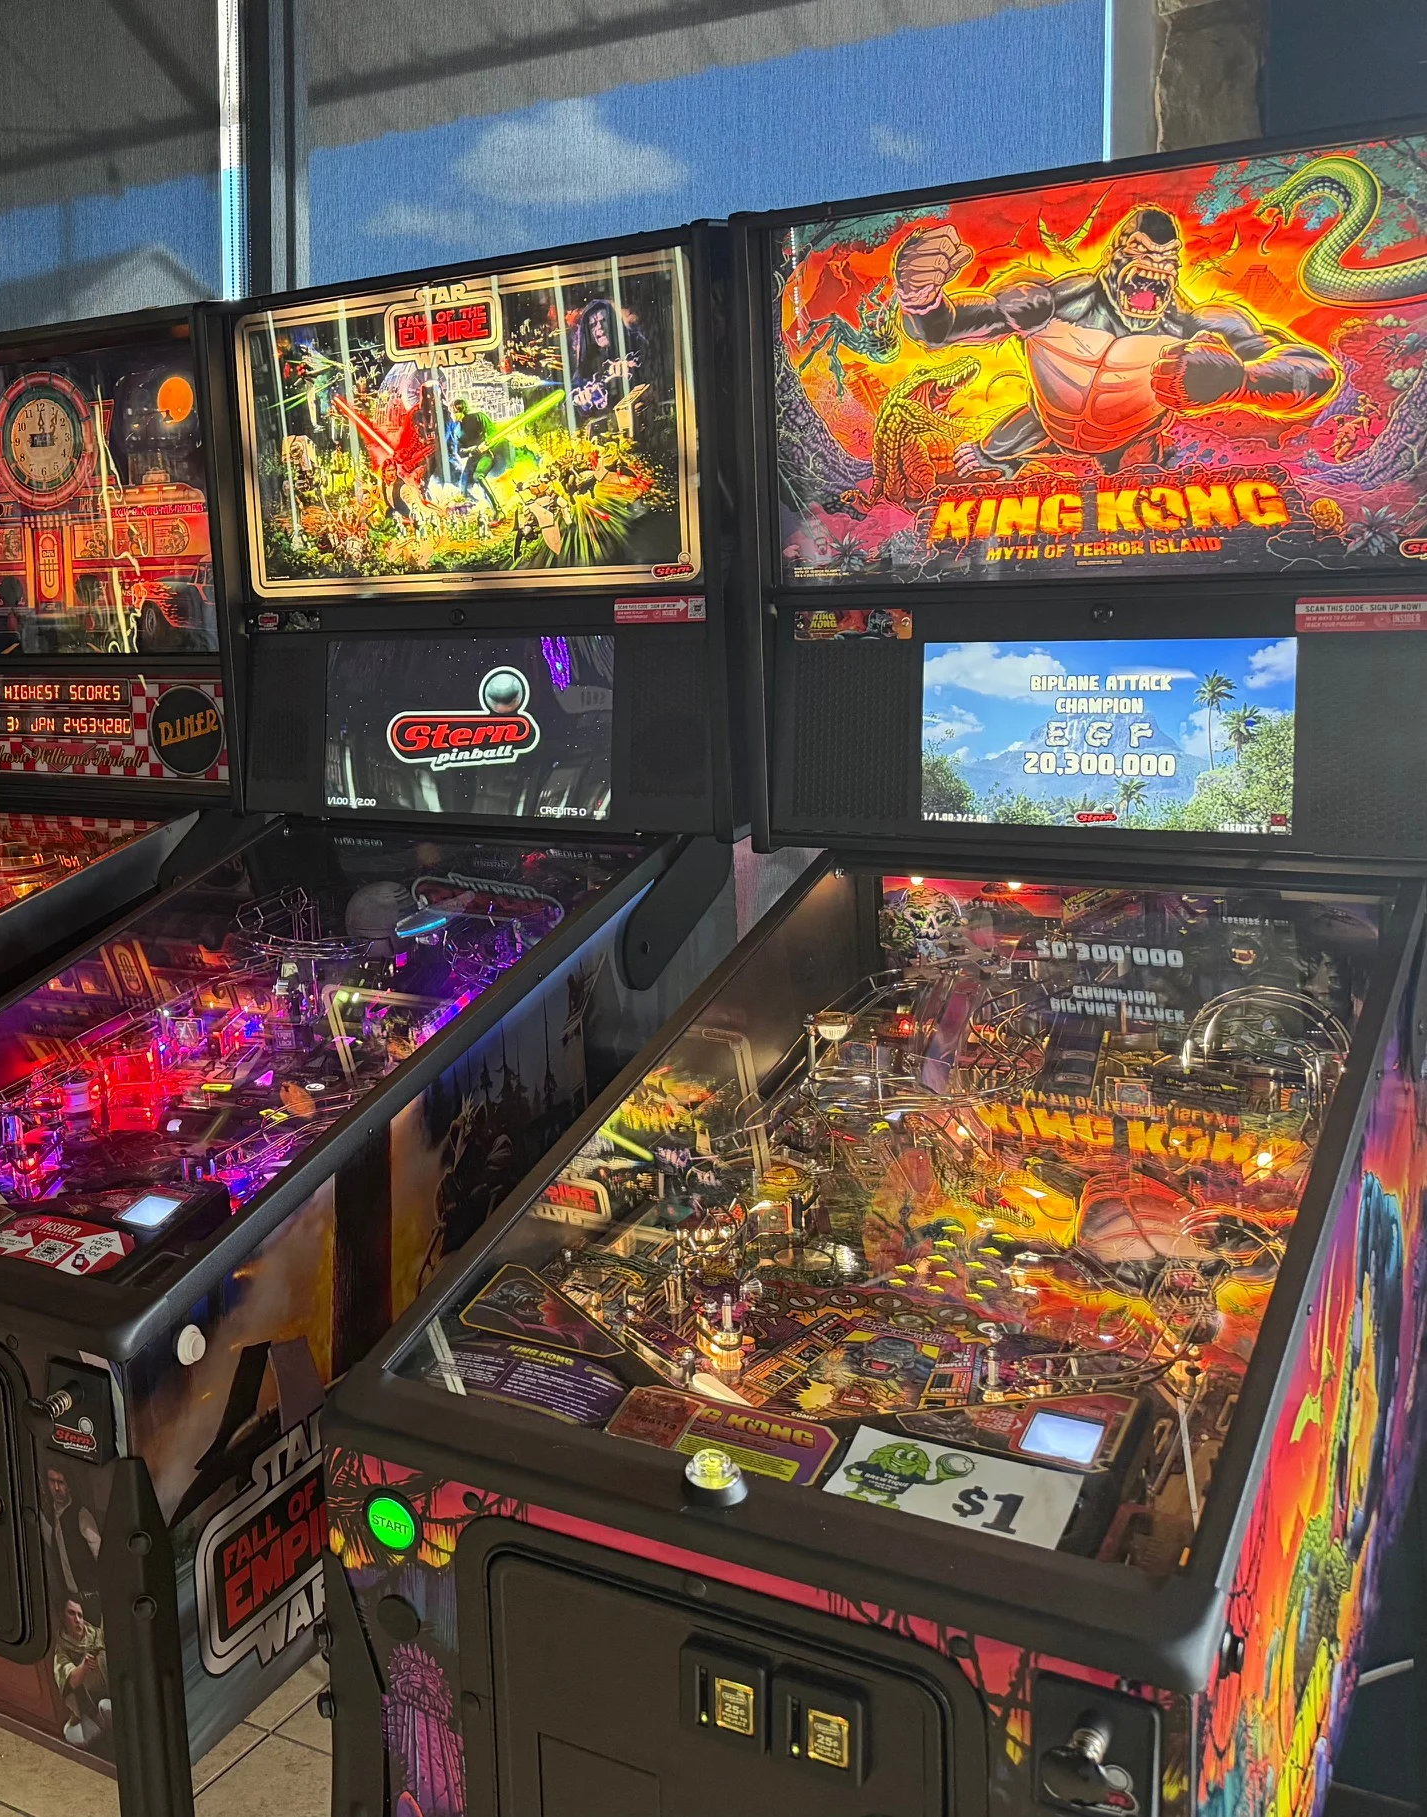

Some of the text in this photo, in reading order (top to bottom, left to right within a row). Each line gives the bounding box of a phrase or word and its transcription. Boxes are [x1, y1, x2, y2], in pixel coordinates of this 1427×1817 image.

[415, 283, 467, 304] STAR
[436, 310, 454, 322] OF
[460, 305, 487, 319] THE
[398, 317, 488, 347] EMPIRE
[414, 348, 476, 369] WARS
[931, 481, 1292, 540] KING KONG
[986, 537, 1222, 562] MYTH OF TERROR ISLAND
[810, 620, 837, 628] KONG
[1392, 613, 1421, 623] INSIDER
[1029, 674, 1173, 692] BIPLANE ATTACK
[4, 684, 121, 701] HIGHEST SCORES
[1055, 697, 1144, 715] CHAMPION
[31, 717, 55, 733] JPN
[159, 708, 219, 748] DINER
[404, 722, 521, 750] Stern
[28, 747, 91, 766] Williams
[92, 748, 146, 768] Pinball
[435, 745, 514, 766] pinball
[1023, 752, 1176, 778] 20,300,000
[539, 806, 578, 816] CREDITS
[1218, 823, 1259, 834] CREDITS
[38, 1220, 82, 1236] INSIDER
[90, 1239, 113, 1249] YOUR
[98, 1235, 116, 1243] USE
[78, 1248, 103, 1258] CODE
[539, 1350, 575, 1366] KONG
[725, 1413, 816, 1449] KONG
[864, 1472, 910, 1488] BREWTIQUE
[952, 1485, 1025, 1535] $1
[223, 1478, 318, 1577] FALL OF
[371, 1513, 409, 1535] START
[722, 1711, 748, 1724] PUSH TO
[724, 1702, 746, 1716] 25¢
[816, 1733, 839, 1747] 25¢
